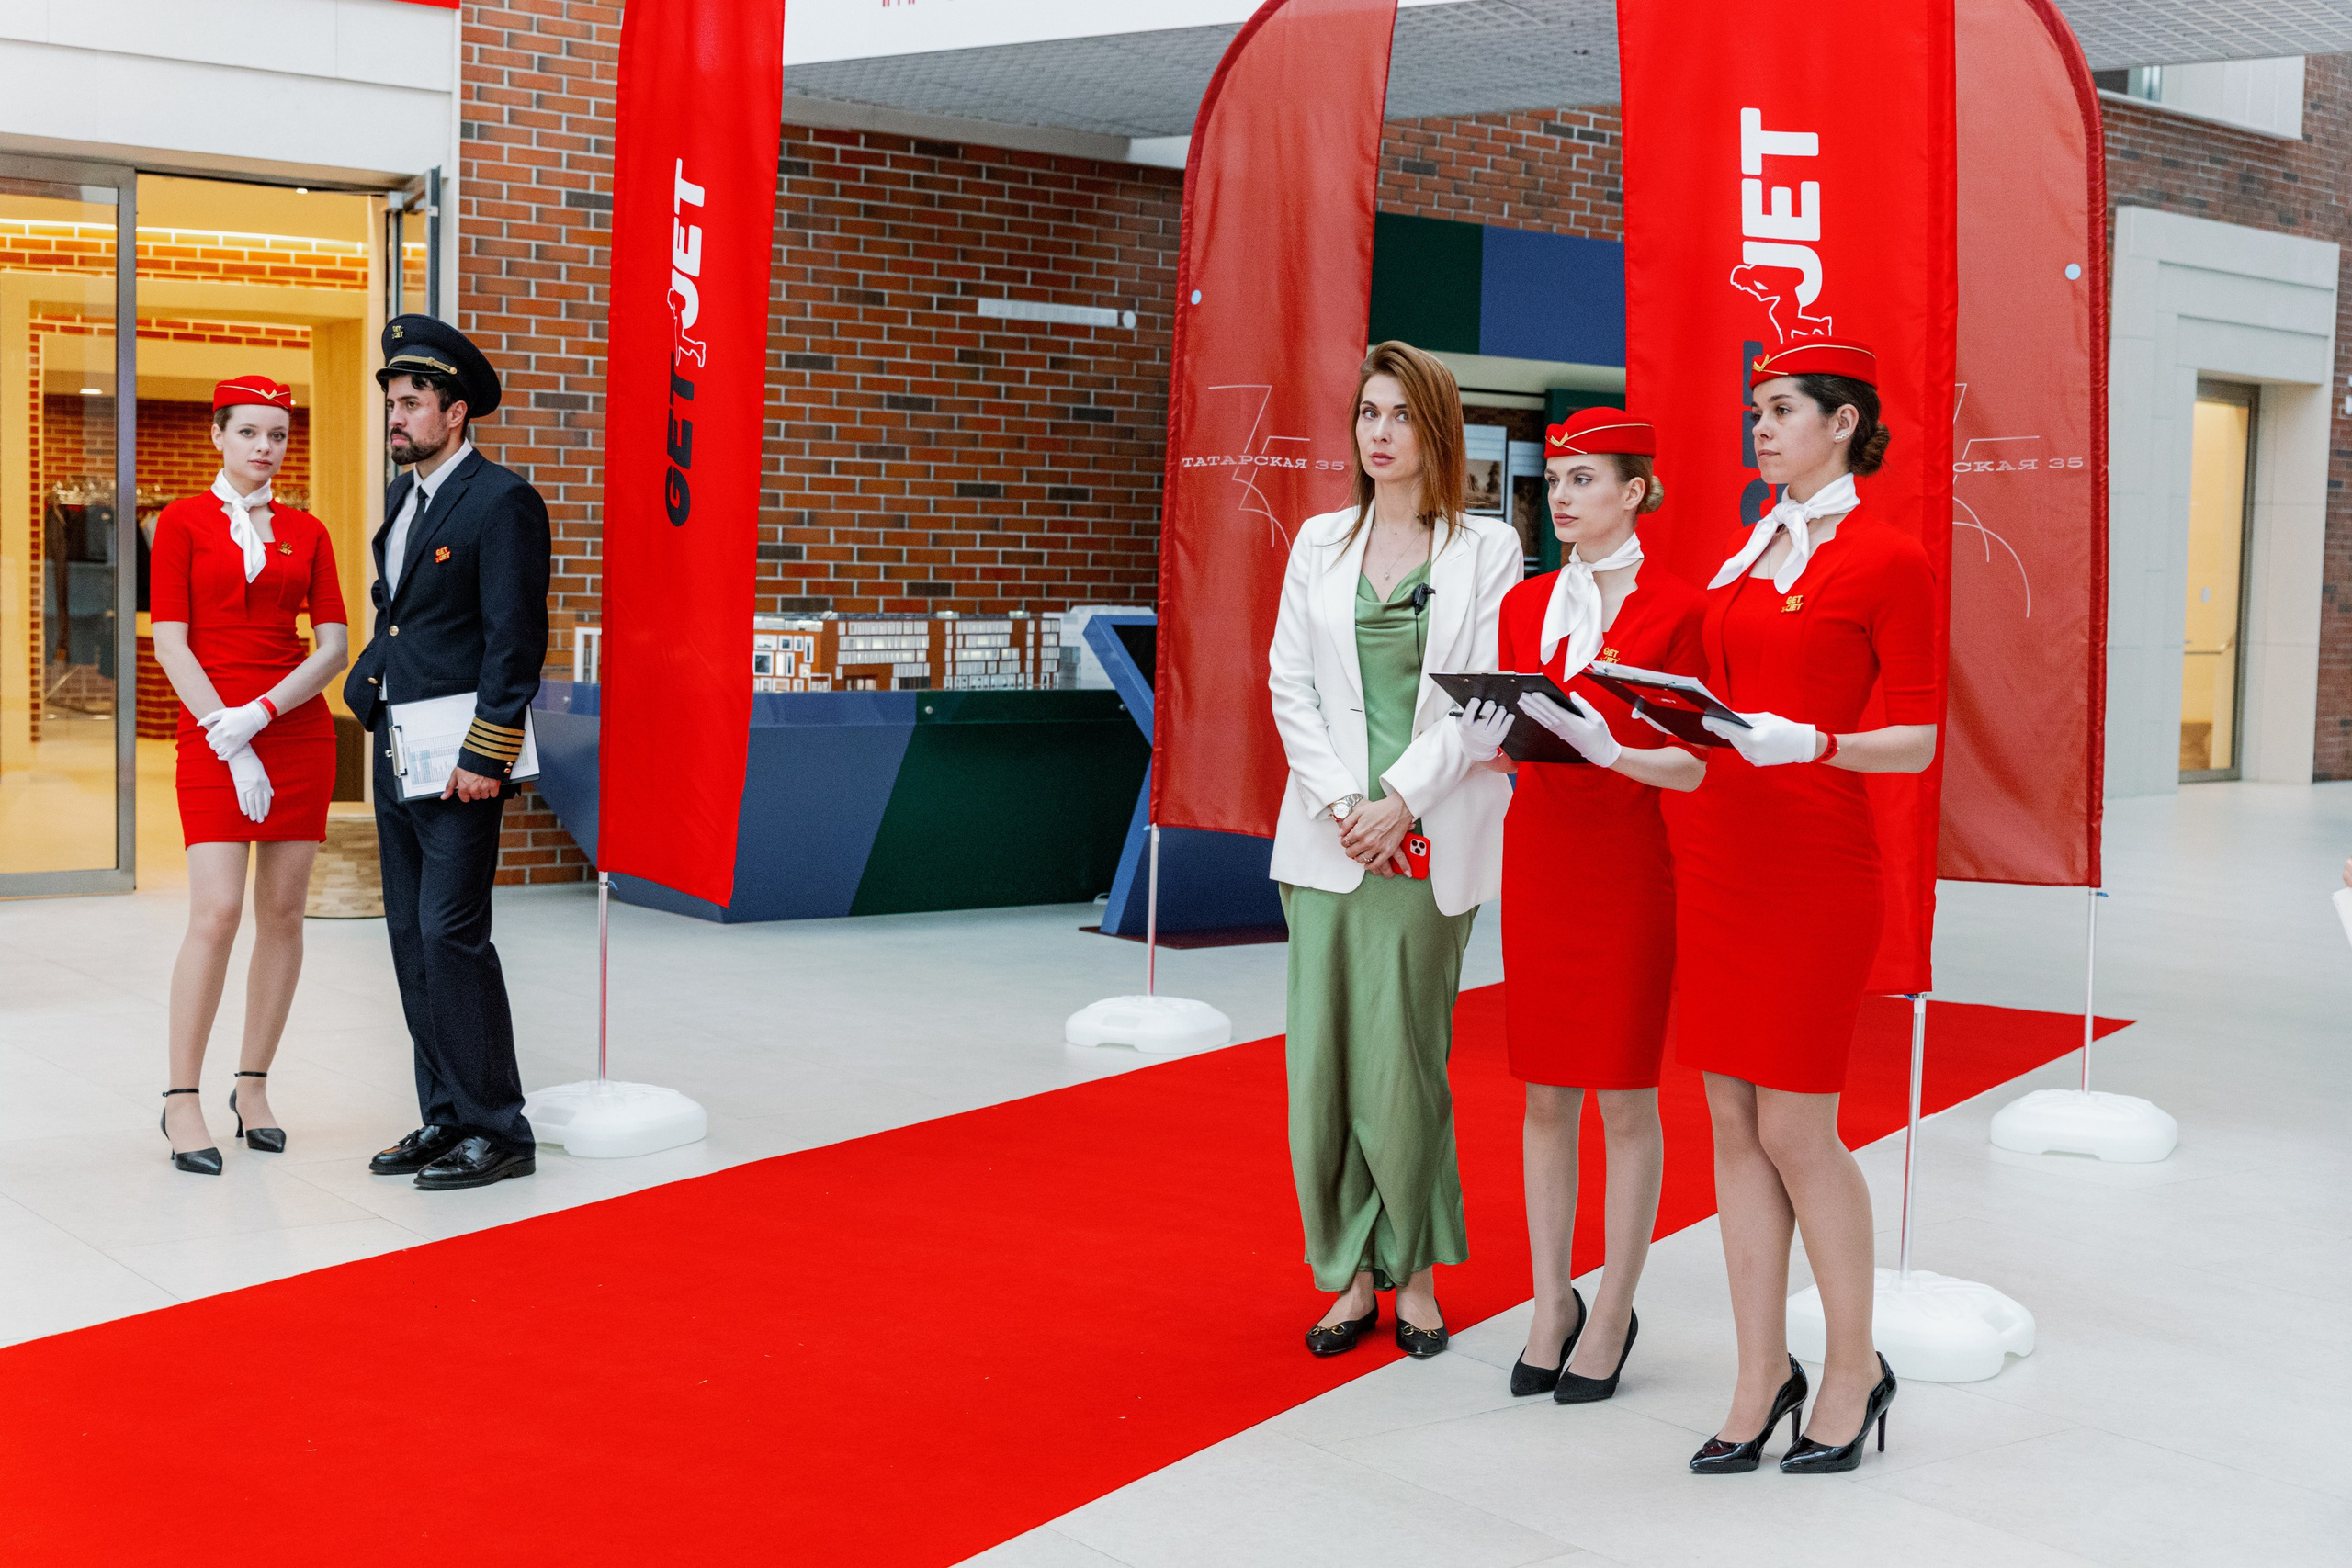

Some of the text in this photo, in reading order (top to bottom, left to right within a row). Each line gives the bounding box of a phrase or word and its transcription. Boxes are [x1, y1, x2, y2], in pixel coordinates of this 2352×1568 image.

[1740, 107, 1823, 308] JET
[664, 157, 706, 527] GET JET
[1182, 455, 1345, 471] ТАТАРСКАЯ 35
[1952, 457, 2084, 473] СКАЯ 35
[435, 546, 448, 557] GET
[1786, 595, 1803, 604] GET
[1785, 603, 1803, 612] JET
[1603, 647, 1619, 659] GET
